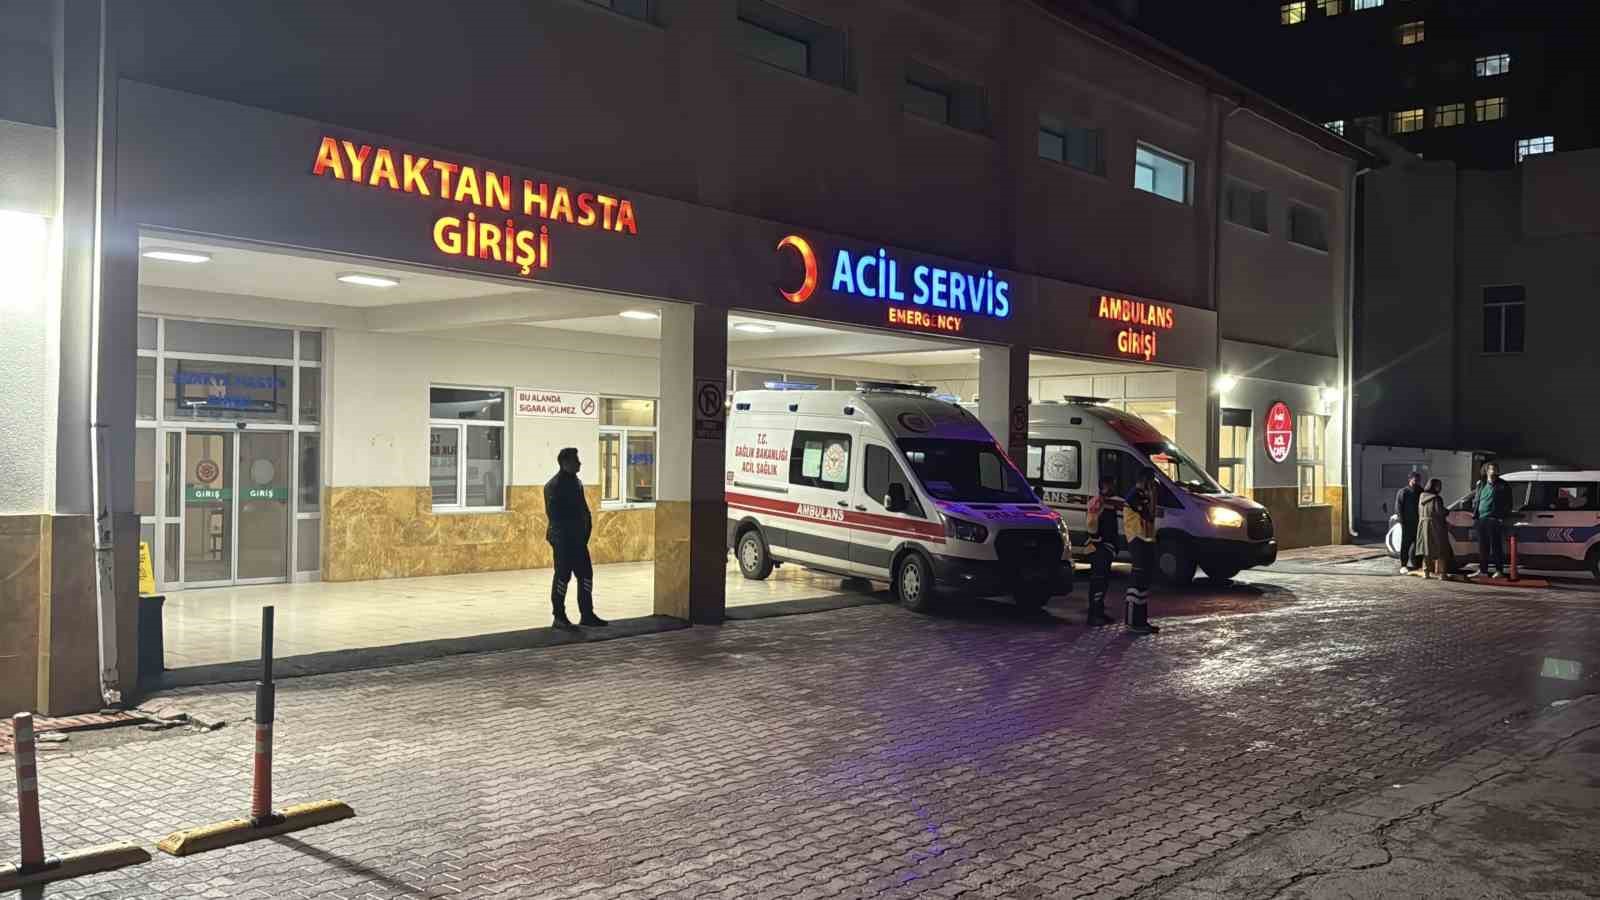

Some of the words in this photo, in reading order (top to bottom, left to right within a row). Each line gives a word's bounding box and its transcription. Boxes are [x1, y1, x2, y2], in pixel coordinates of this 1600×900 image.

[312, 135, 512, 212] AYAKTAN
[522, 178, 639, 235] HASTA
[432, 211, 550, 276] GİRİŞİ
[832, 247, 905, 301] ACİL
[912, 269, 1010, 318] SERVİS
[888, 307, 962, 331] EMERGENCY
[1098, 295, 1175, 329] AMBULANS
[1117, 327, 1157, 361] GİRİŞİ
[519, 392, 531, 402] BU
[532, 393, 562, 404] ALANDA
[796, 502, 845, 521] AMBULANS
